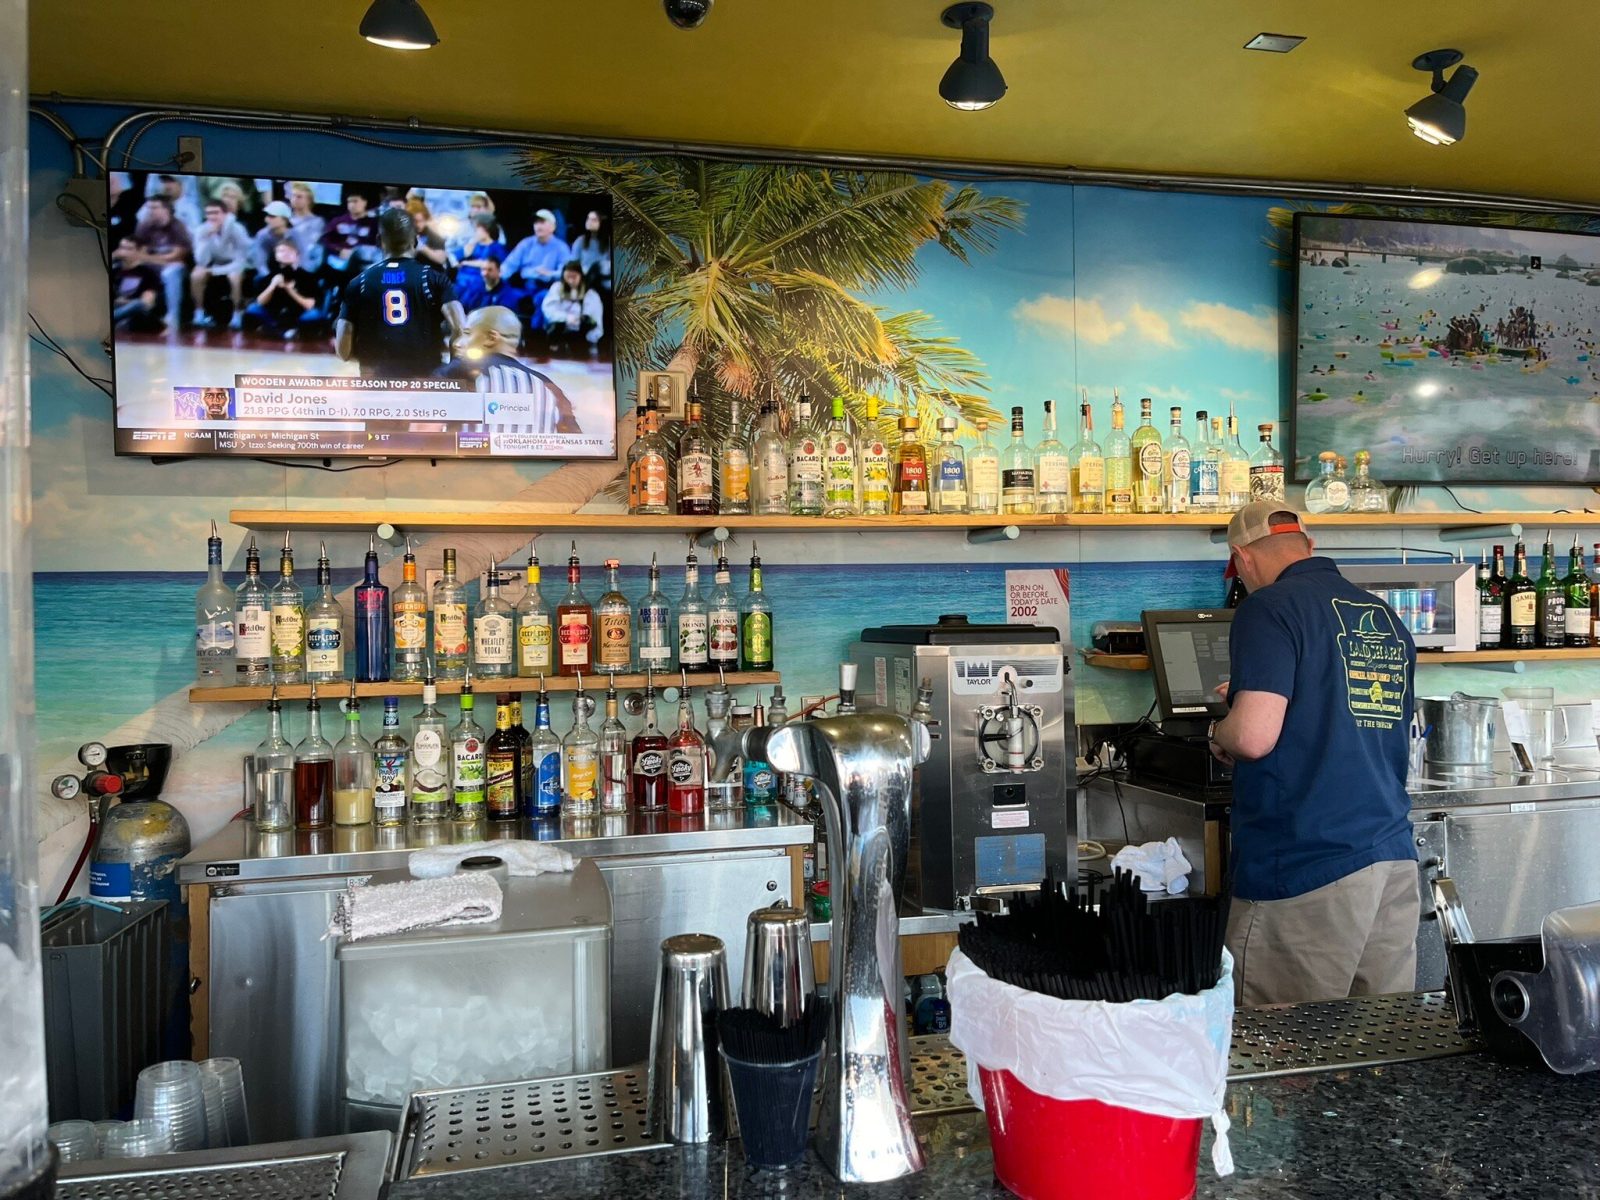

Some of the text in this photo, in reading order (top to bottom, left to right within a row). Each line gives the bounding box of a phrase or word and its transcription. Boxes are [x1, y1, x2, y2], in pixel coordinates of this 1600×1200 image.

[381, 271, 405, 284] JONES
[382, 289, 409, 326] 8
[241, 377, 460, 390] WOODEN AWARD LATE SEASON TOP 20 SPECIAL
[243, 392, 327, 405] David Jones
[243, 406, 264, 415] 21.8
[266, 407, 290, 415] PPG
[292, 406, 313, 416] (4th
[316, 407, 326, 416] in
[353, 408, 366, 417] 7.0
[369, 409, 394, 418] RPG,
[396, 409, 410, 417] 2.0
[413, 409, 430, 417] Stls
[432, 409, 448, 418] PG
[500, 404, 530, 412] Principal
[184, 431, 212, 439] NCAAM
[219, 431, 256, 441] Michigan
[271, 432, 307, 442] Michigan
[310, 432, 320, 440] St
[267, 442, 296, 451] Seeking
[1402, 447, 1578, 468] Hurry! Get up here!
[905, 466, 923, 475] 1800
[943, 466, 961, 475] 1800
[1010, 597, 1058, 606] TODAY'S DATE
[640, 607, 669, 616] ABSOLUT
[1011, 606, 1038, 617] 2002
[275, 615, 289, 625] Ketel
[604, 617, 628, 626] Tito's
[642, 615, 667, 624] VODKA
[239, 623, 255, 636] Ketel
[255, 624, 266, 632] One
[309, 633, 339, 641] DEEP EDDY
[481, 638, 505, 646] WHEATLEY
[484, 646, 501, 655] VODKA
